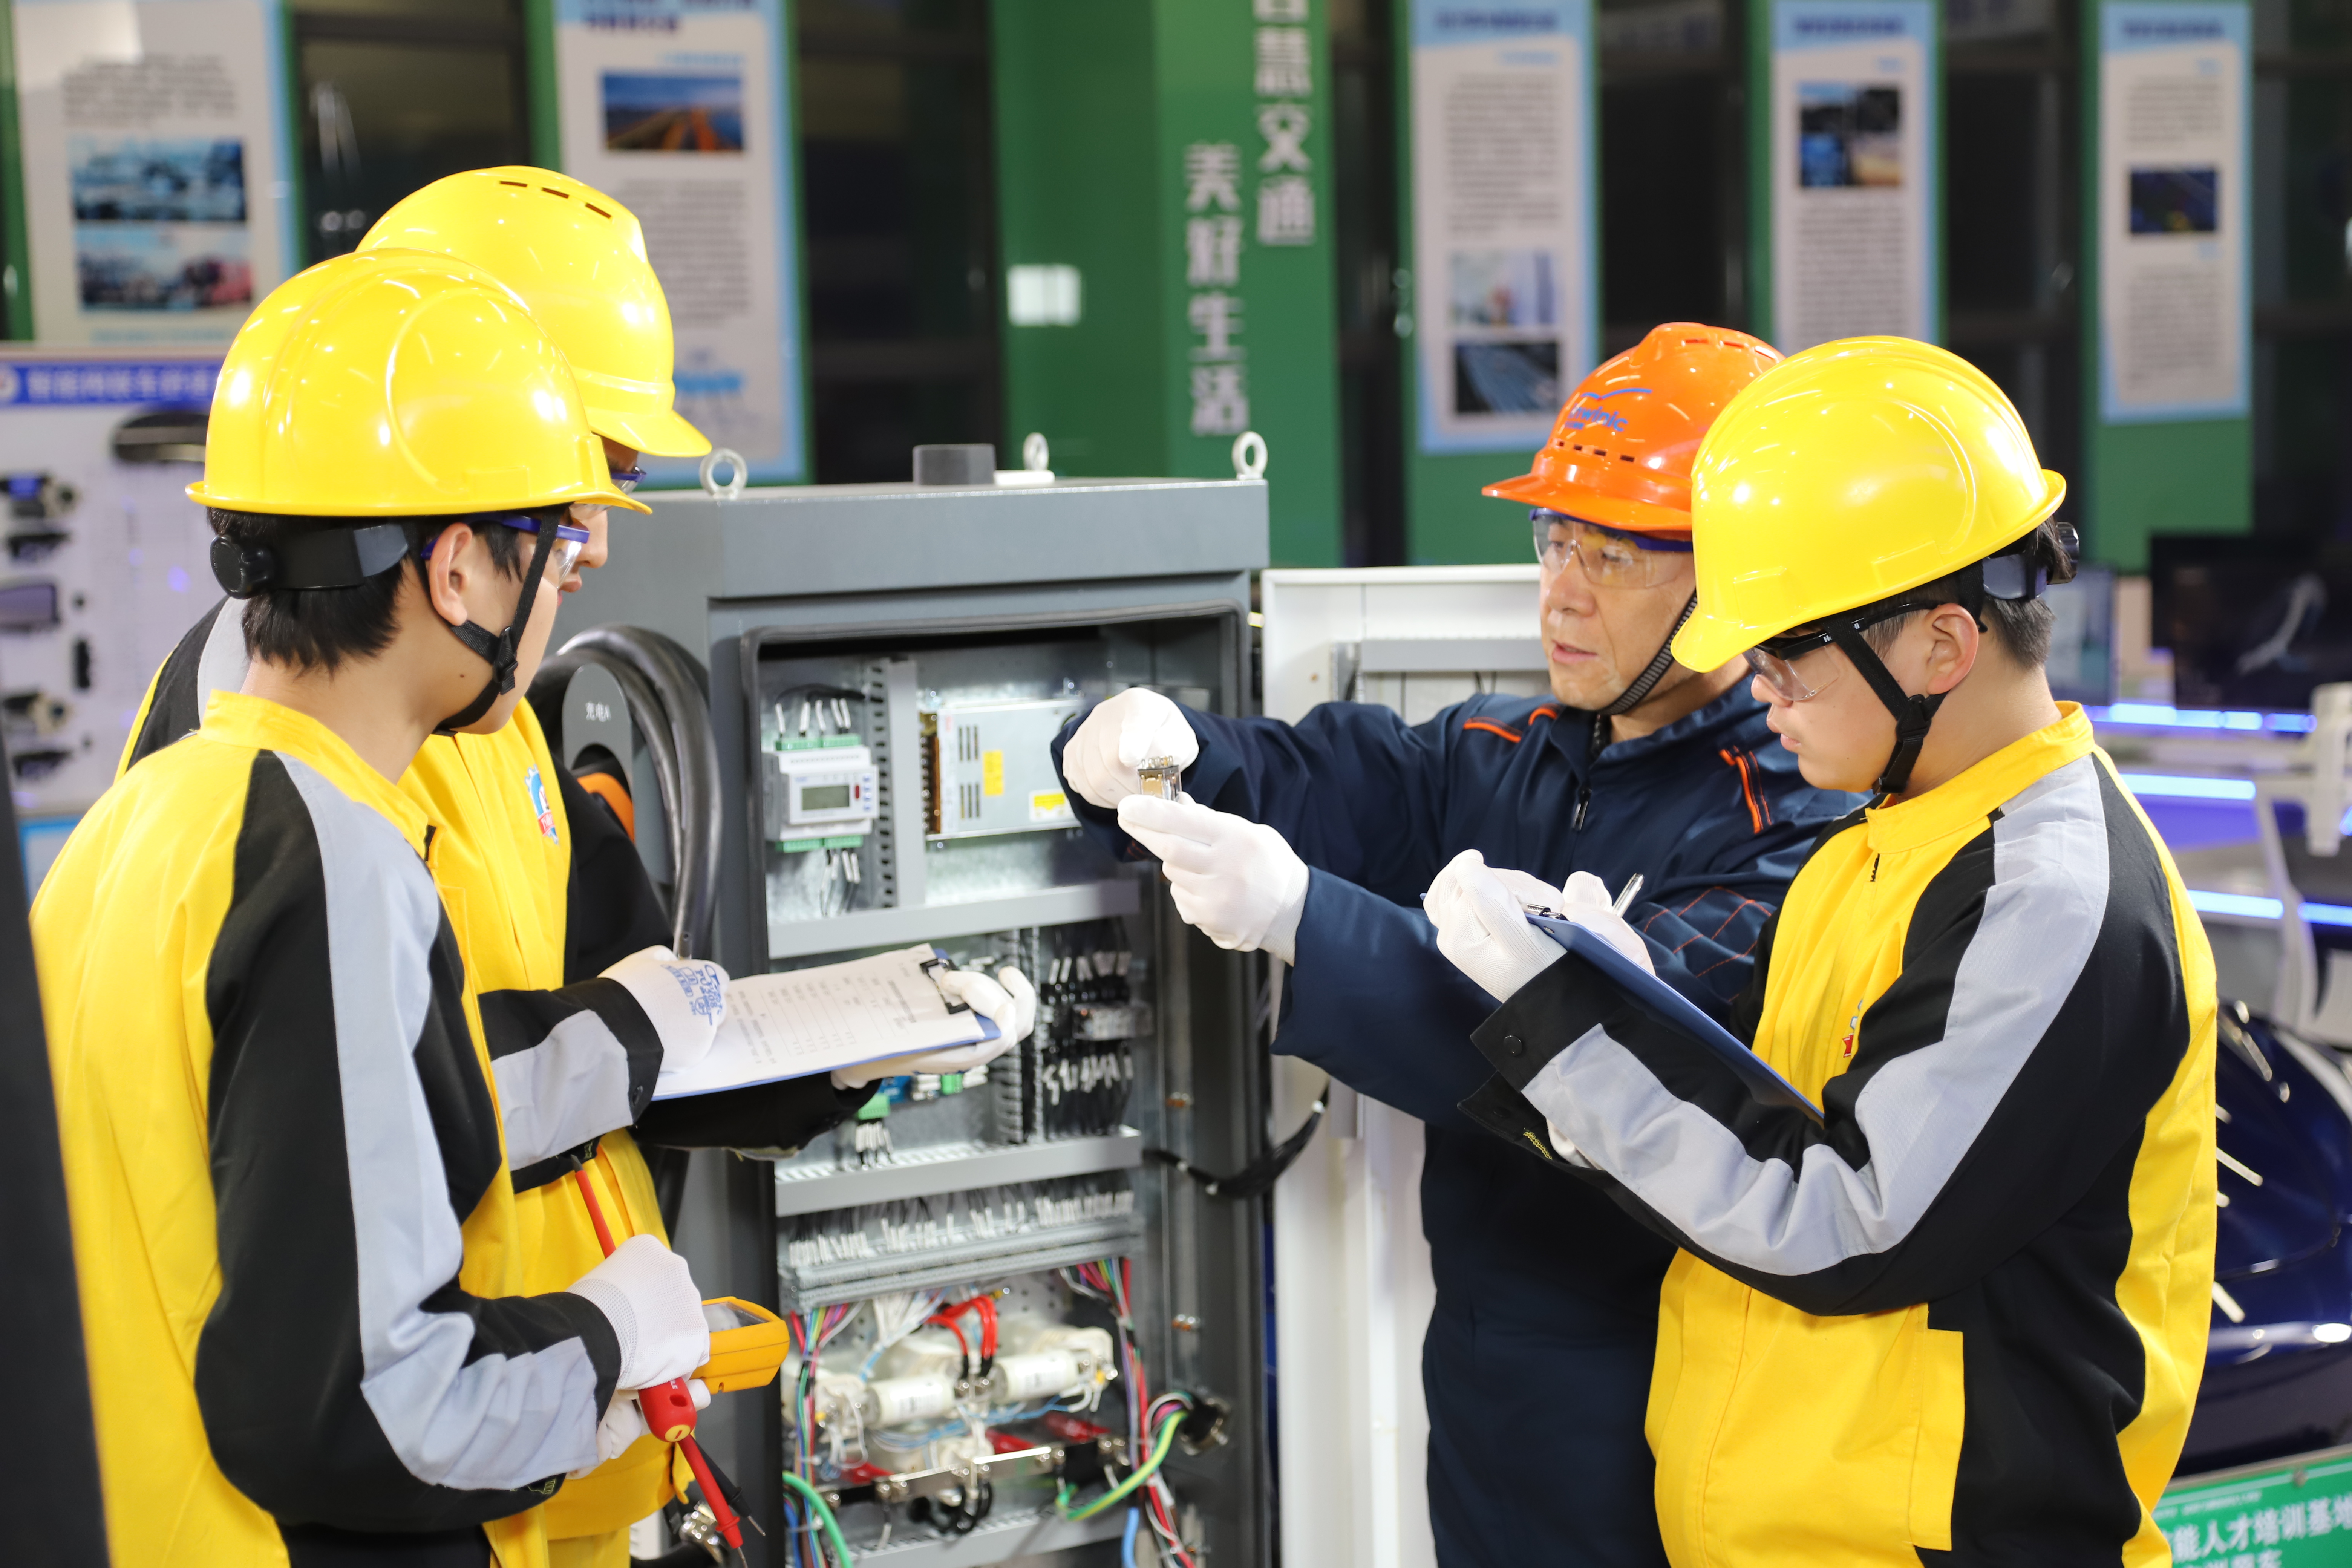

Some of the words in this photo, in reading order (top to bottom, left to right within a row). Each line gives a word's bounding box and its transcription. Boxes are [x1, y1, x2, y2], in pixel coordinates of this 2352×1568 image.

[2167, 1492, 2352, 1563] 能人才培训基地
